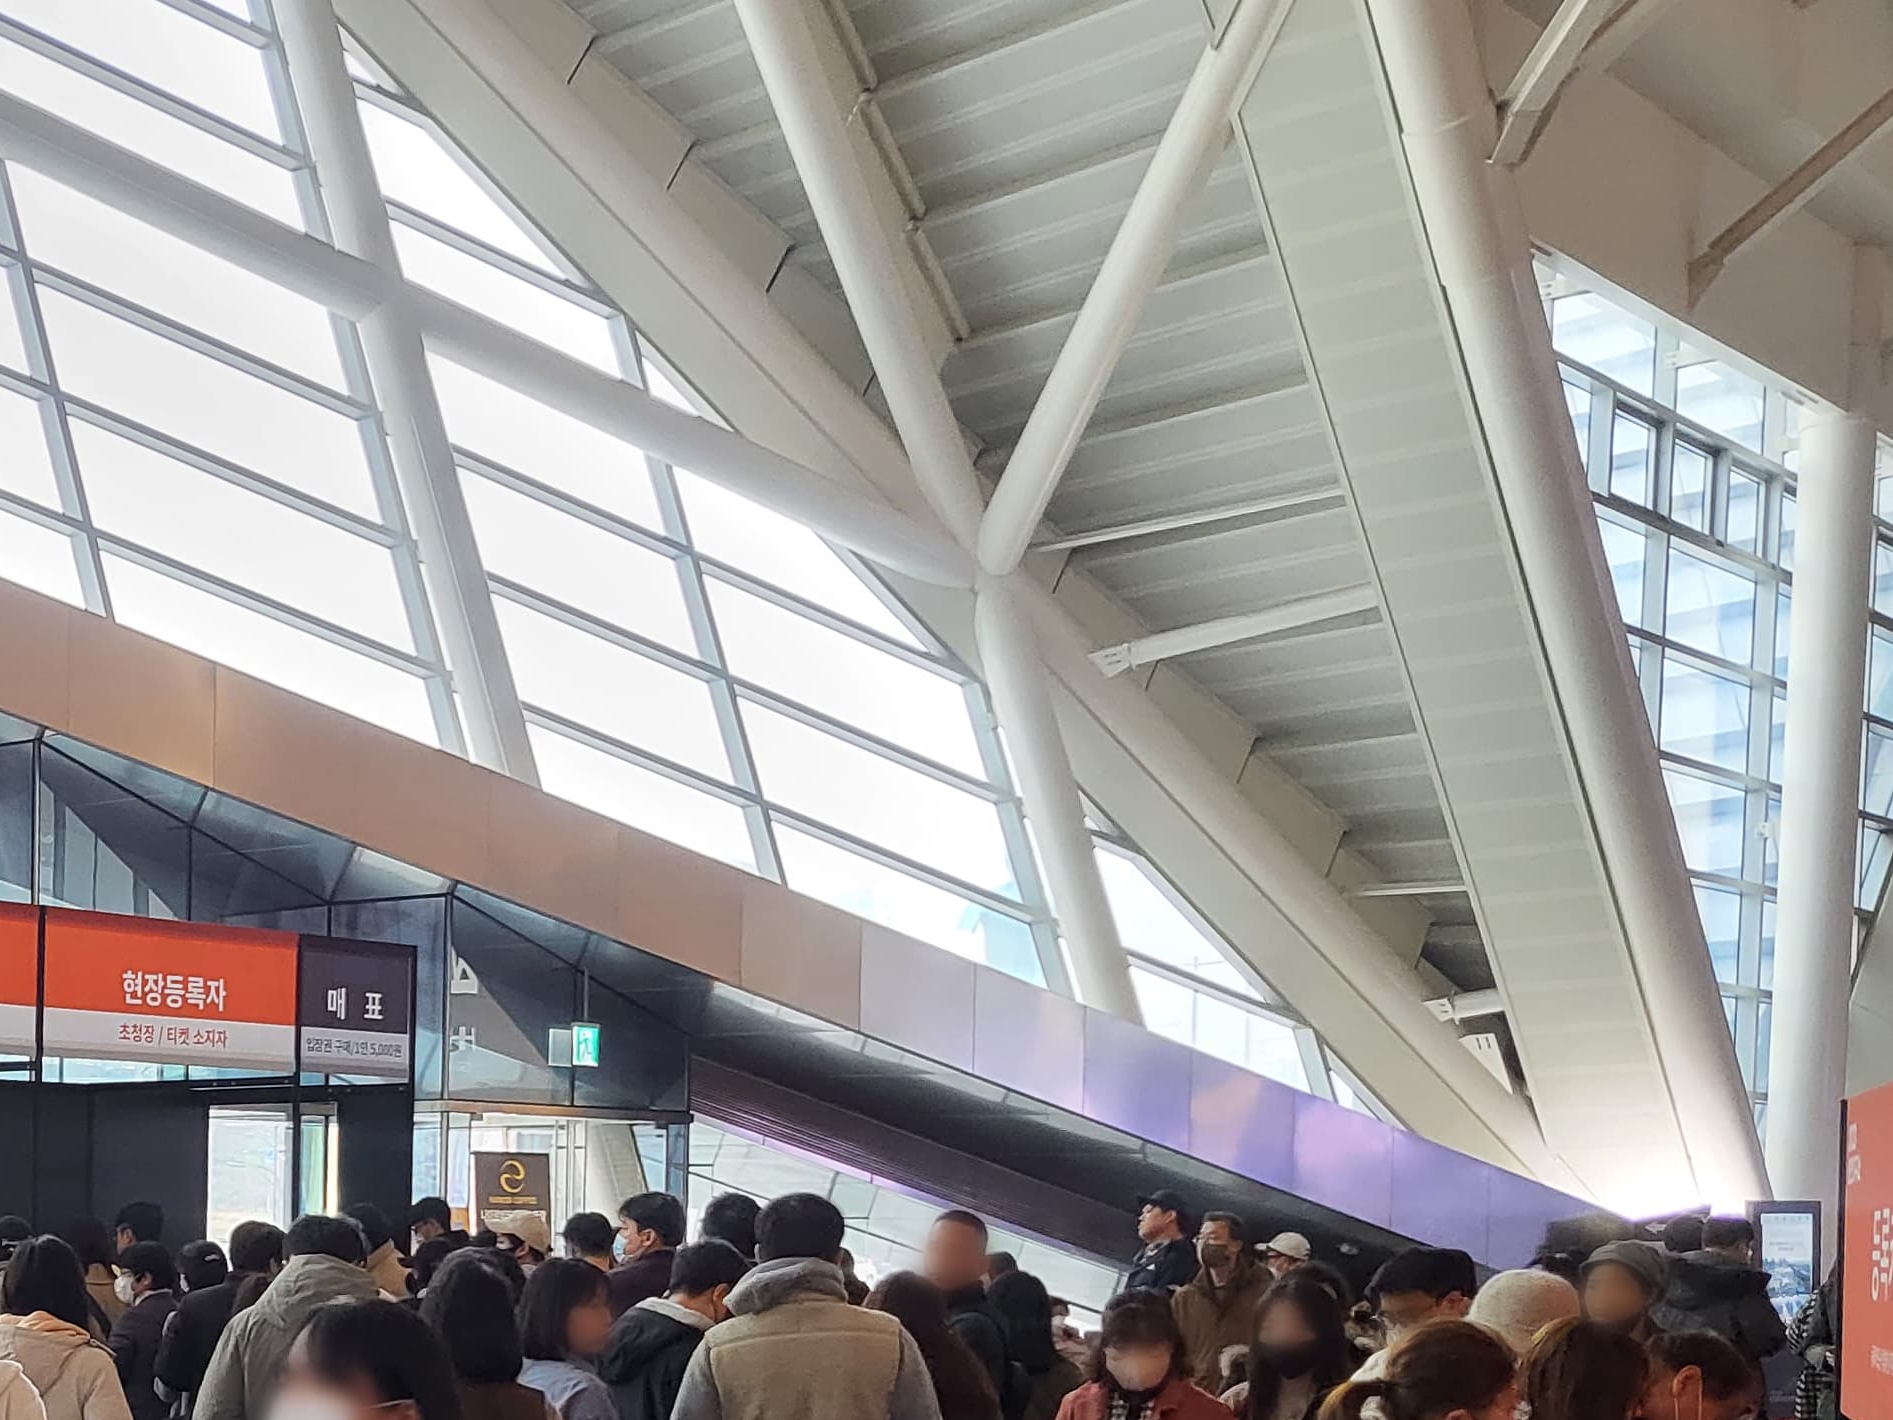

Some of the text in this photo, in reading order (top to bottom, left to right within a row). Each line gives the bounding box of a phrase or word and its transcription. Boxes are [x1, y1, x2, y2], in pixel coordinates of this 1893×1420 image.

[121, 969, 227, 1012] 현장등록자
[118, 1022, 155, 1044] 초청장
[166, 1026, 190, 1046] 티켓
[192, 1028, 228, 1048] 소지자
[306, 1037, 332, 1053] 입장권
[1871, 1207, 1893, 1302] 등록
